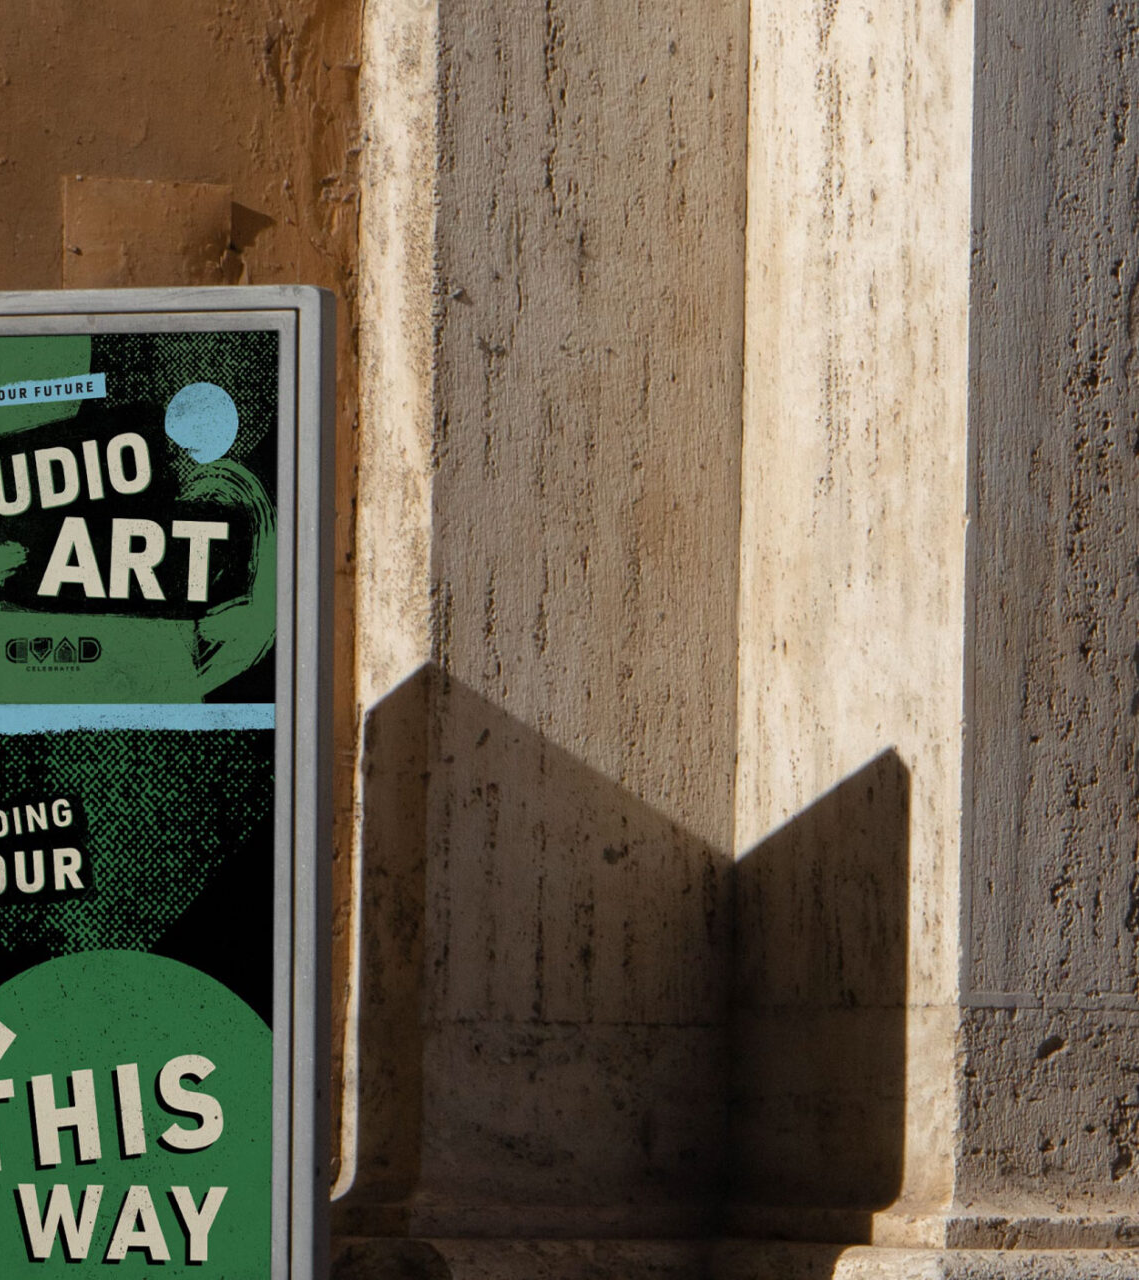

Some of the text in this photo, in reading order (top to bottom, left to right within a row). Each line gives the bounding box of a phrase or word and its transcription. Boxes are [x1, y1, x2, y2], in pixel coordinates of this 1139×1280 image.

[34, 381, 94, 397] FUTURE
[37, 516, 229, 602] ART
[17, 1183, 229, 1262] WAY
